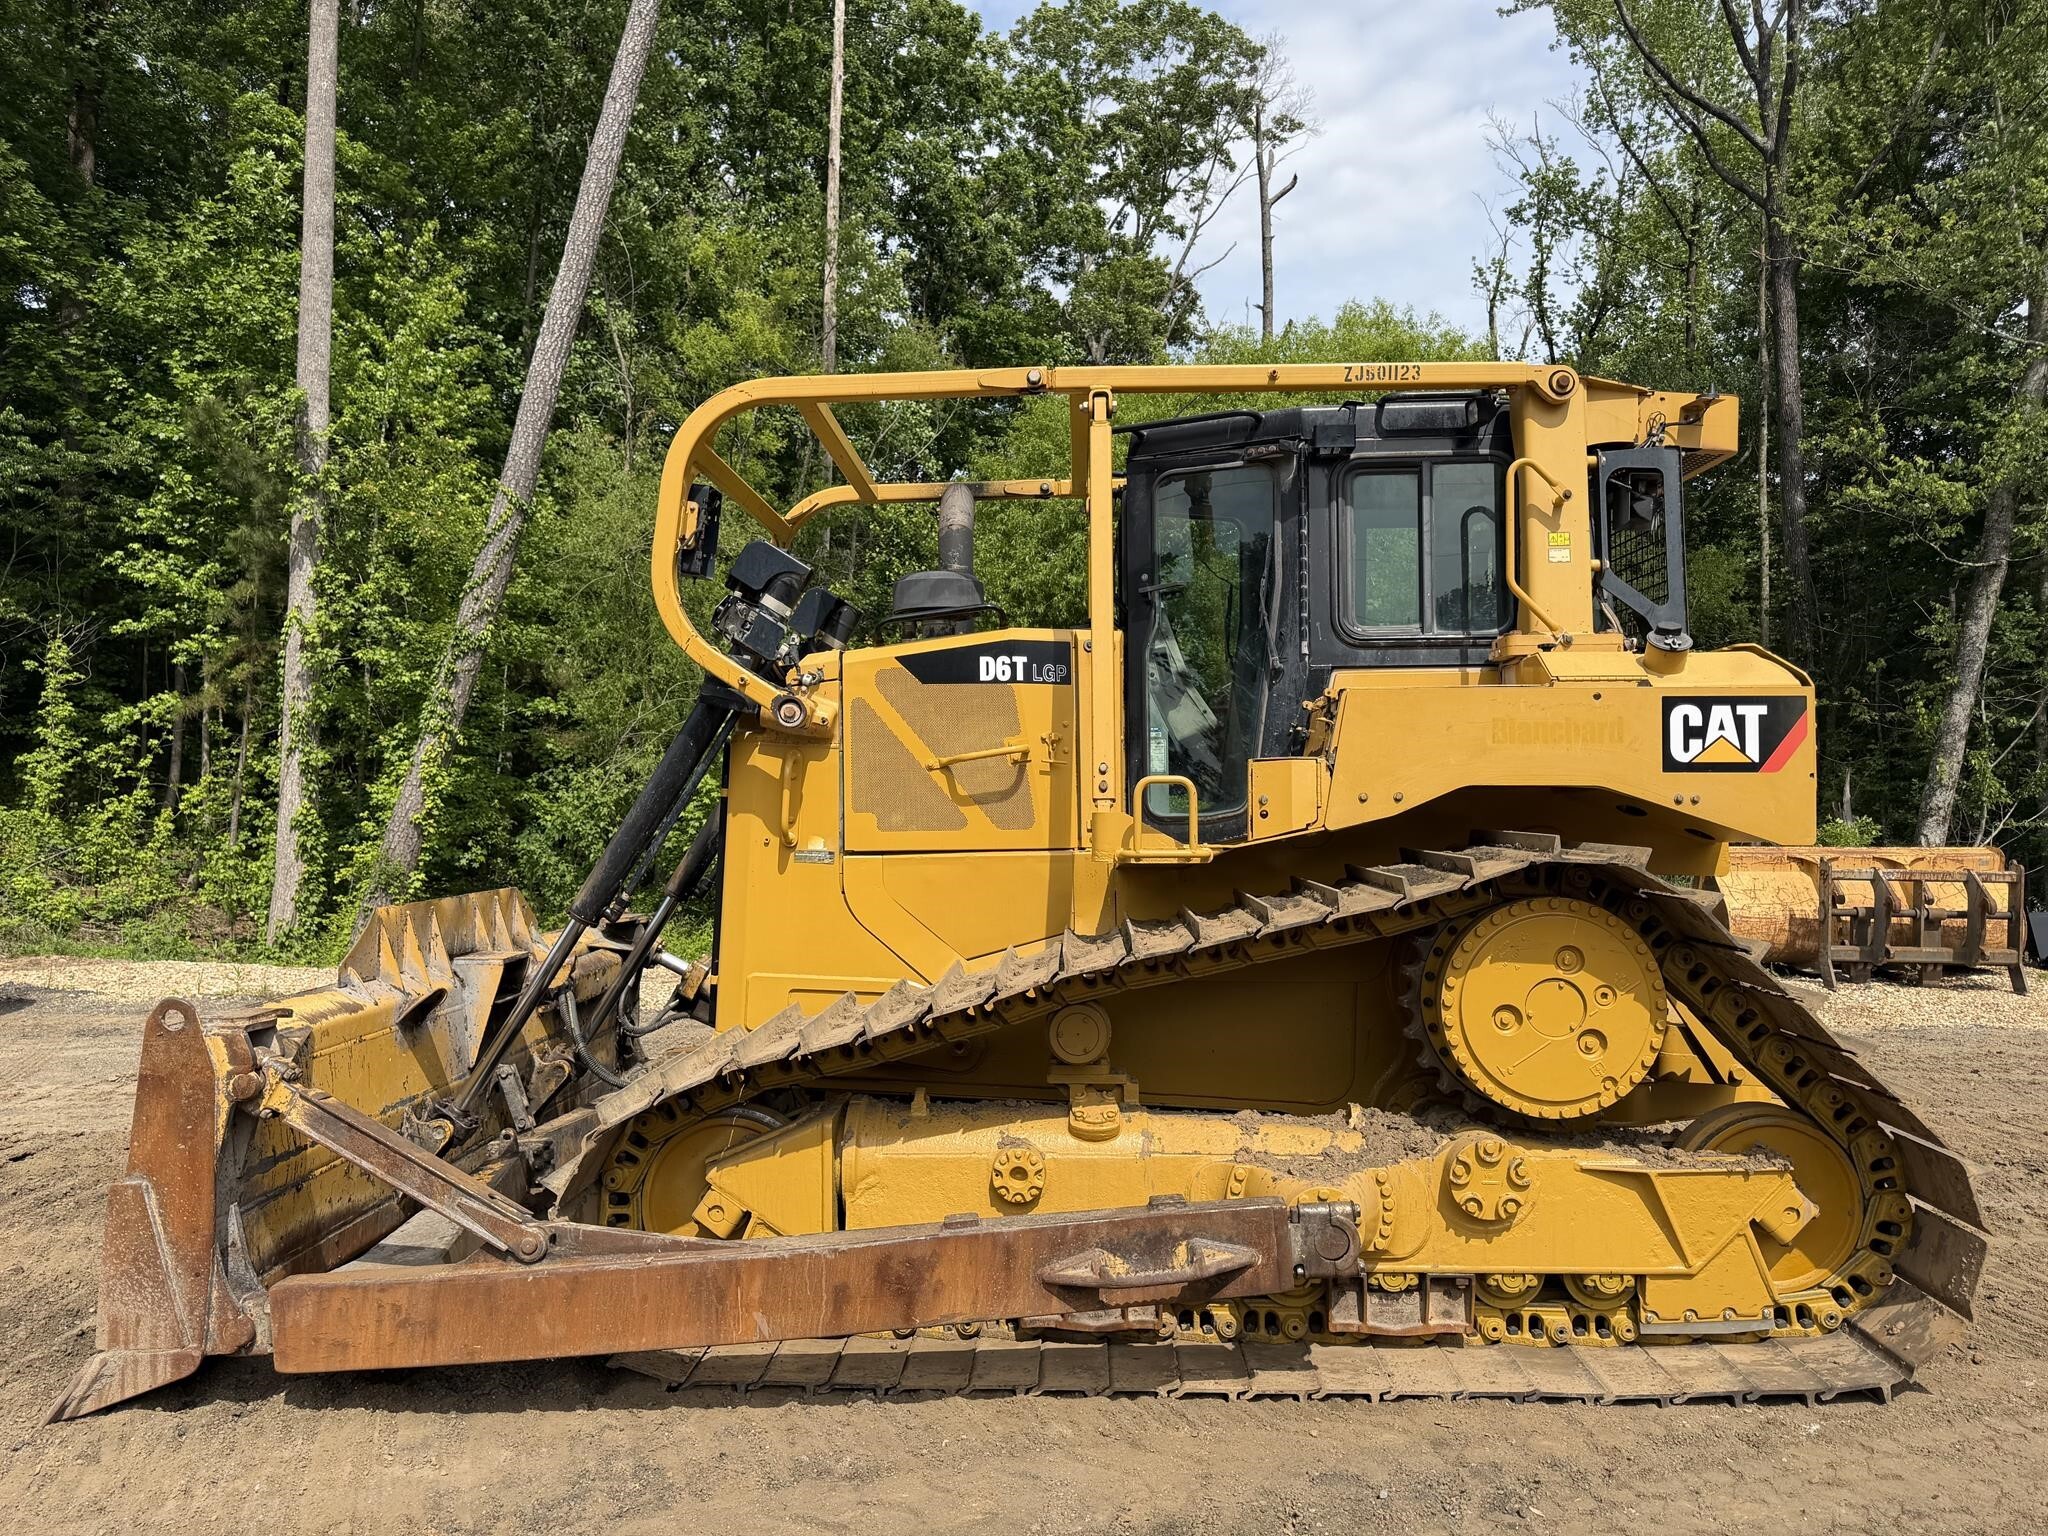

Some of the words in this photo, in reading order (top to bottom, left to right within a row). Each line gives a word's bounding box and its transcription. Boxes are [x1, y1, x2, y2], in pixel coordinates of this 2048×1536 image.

[979, 655, 1028, 682] D6T
[1032, 663, 1067, 682] LGP
[1669, 703, 1768, 763] CAT
